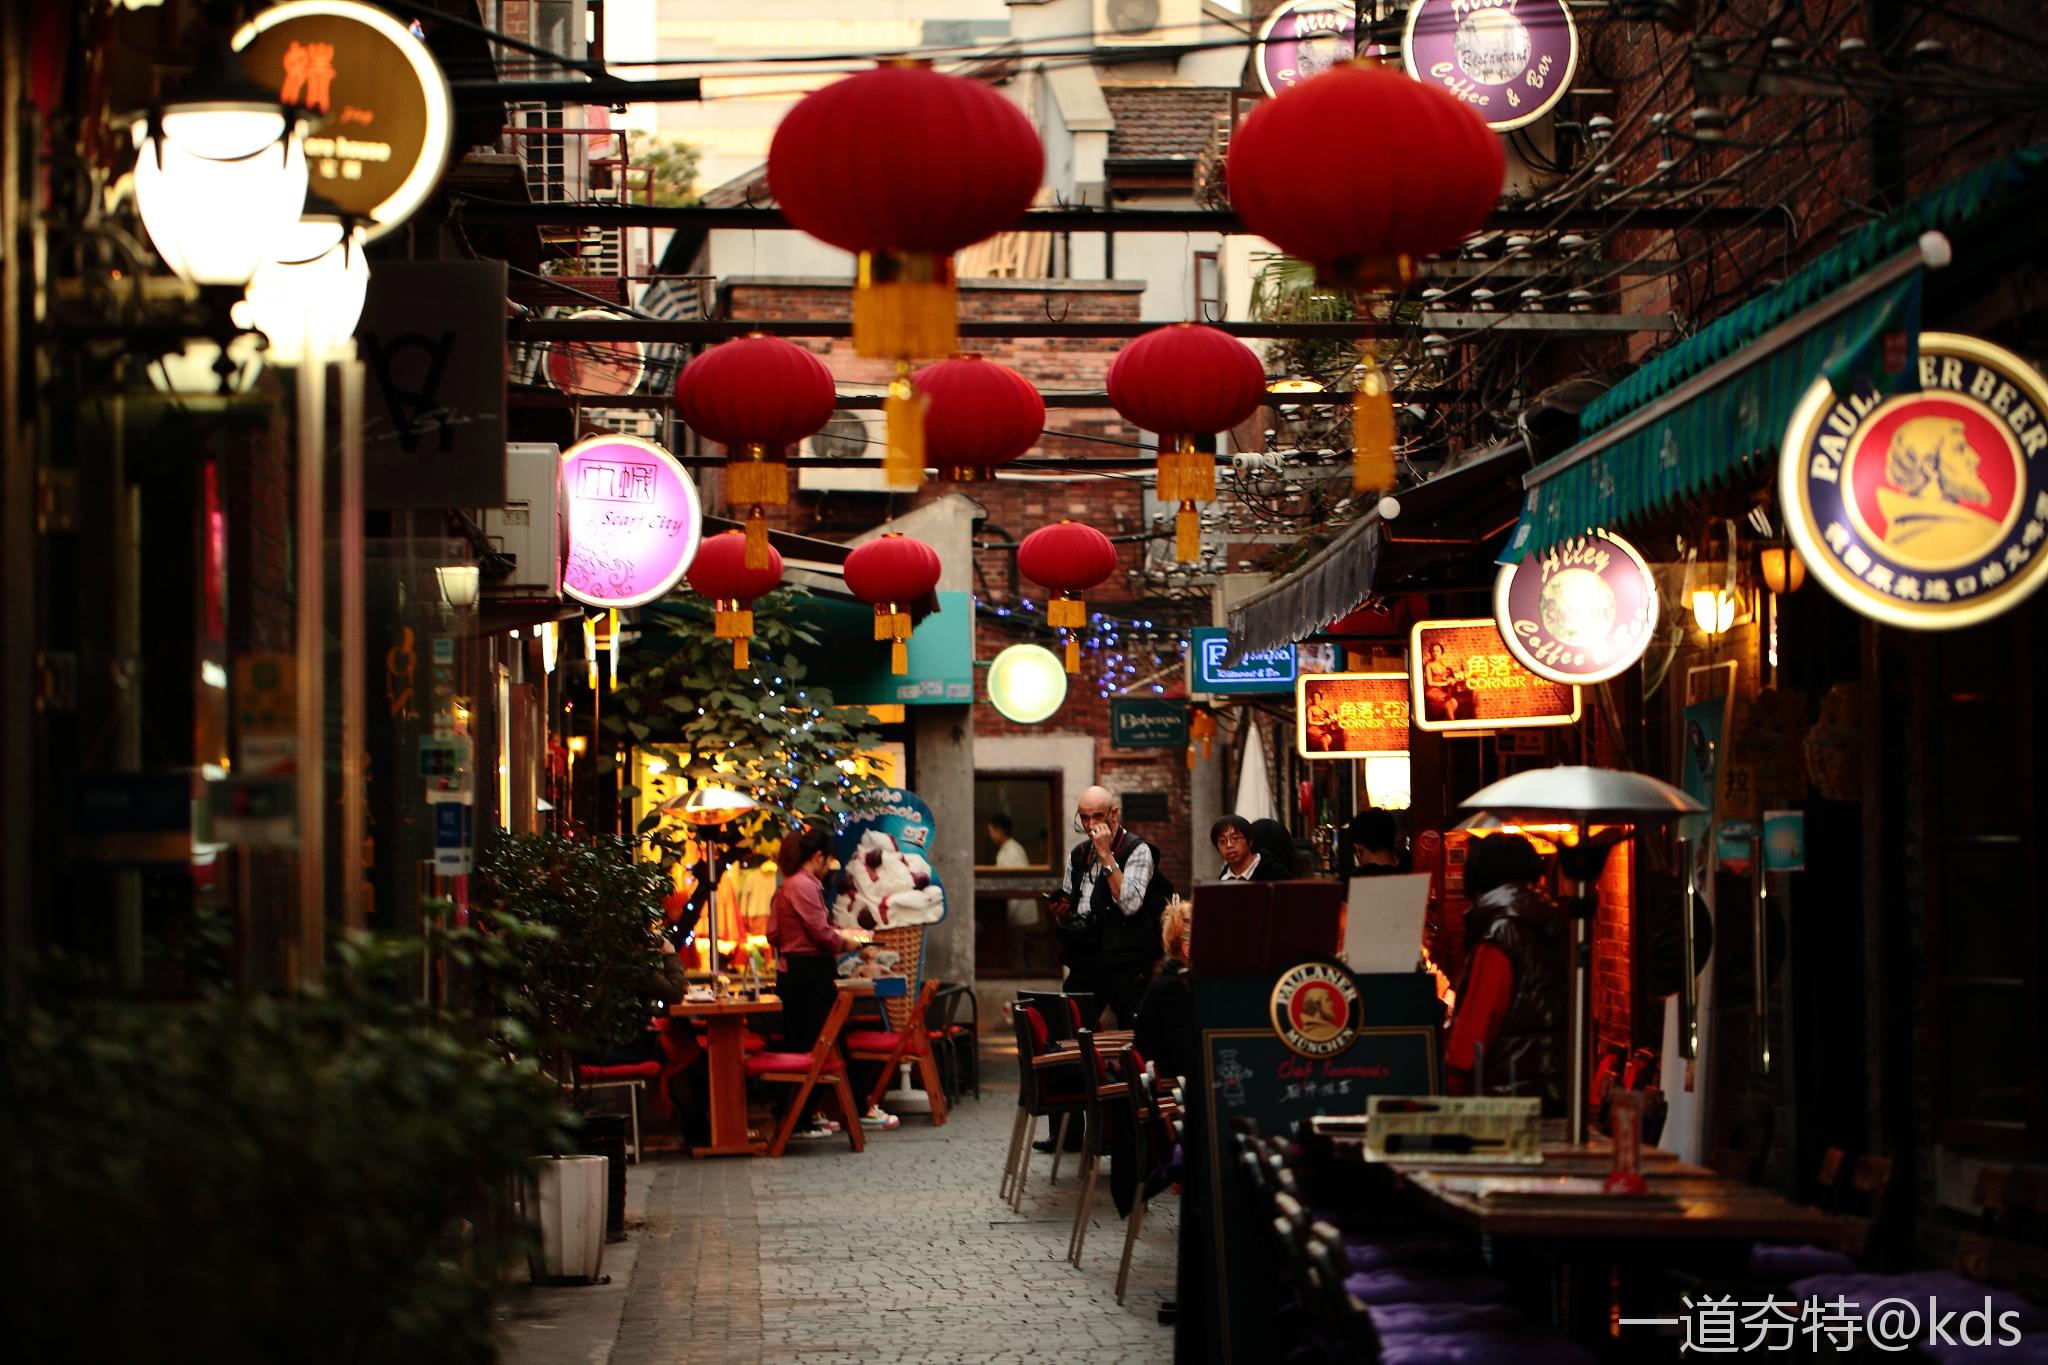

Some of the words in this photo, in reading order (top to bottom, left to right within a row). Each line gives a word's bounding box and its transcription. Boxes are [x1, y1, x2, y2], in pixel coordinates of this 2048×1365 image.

[1430, 62, 1490, 106] Coffee
[1506, 87, 1521, 108] &
[1526, 54, 1553, 89] Bar
[1970, 365, 2048, 459] BEER
[648, 514, 684, 537] City
[1541, 537, 1611, 584] Alley
[1513, 619, 1586, 666] Coffee
[1465, 676, 1528, 689] CORNER
[1338, 718, 1386, 729] CORNER
[1277, 966, 1358, 1005] PAULANER
